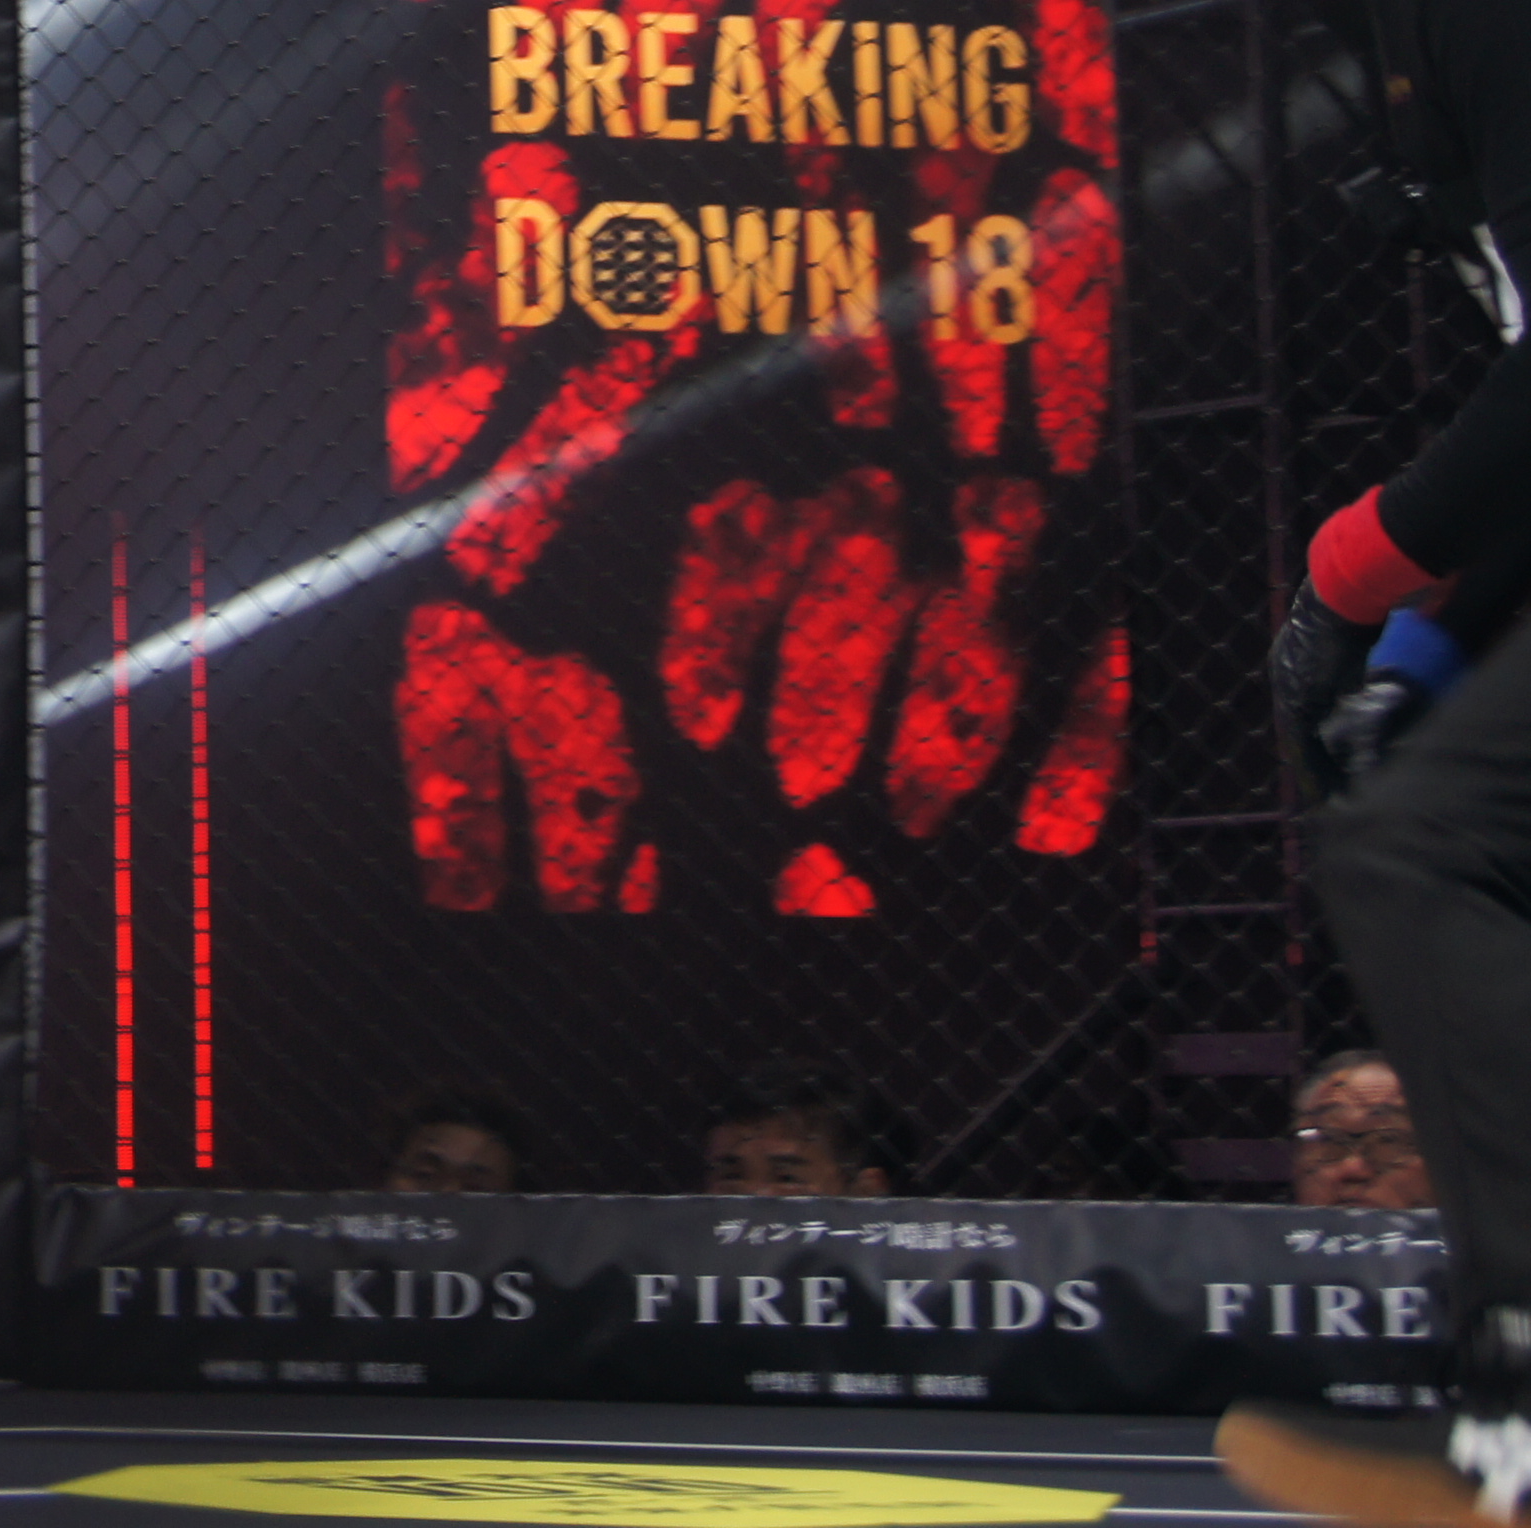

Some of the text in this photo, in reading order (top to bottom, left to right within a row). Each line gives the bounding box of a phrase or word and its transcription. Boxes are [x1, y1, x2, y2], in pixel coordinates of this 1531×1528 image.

[488, 5, 1032, 153] BREAKING
[495, 197, 1034, 345] DOWN 18
[98, 1266, 537, 1320] FIRE KIDS
[633, 1274, 1102, 1331] FIRE KIDS
[1204, 1283, 1433, 1339] FIRE
